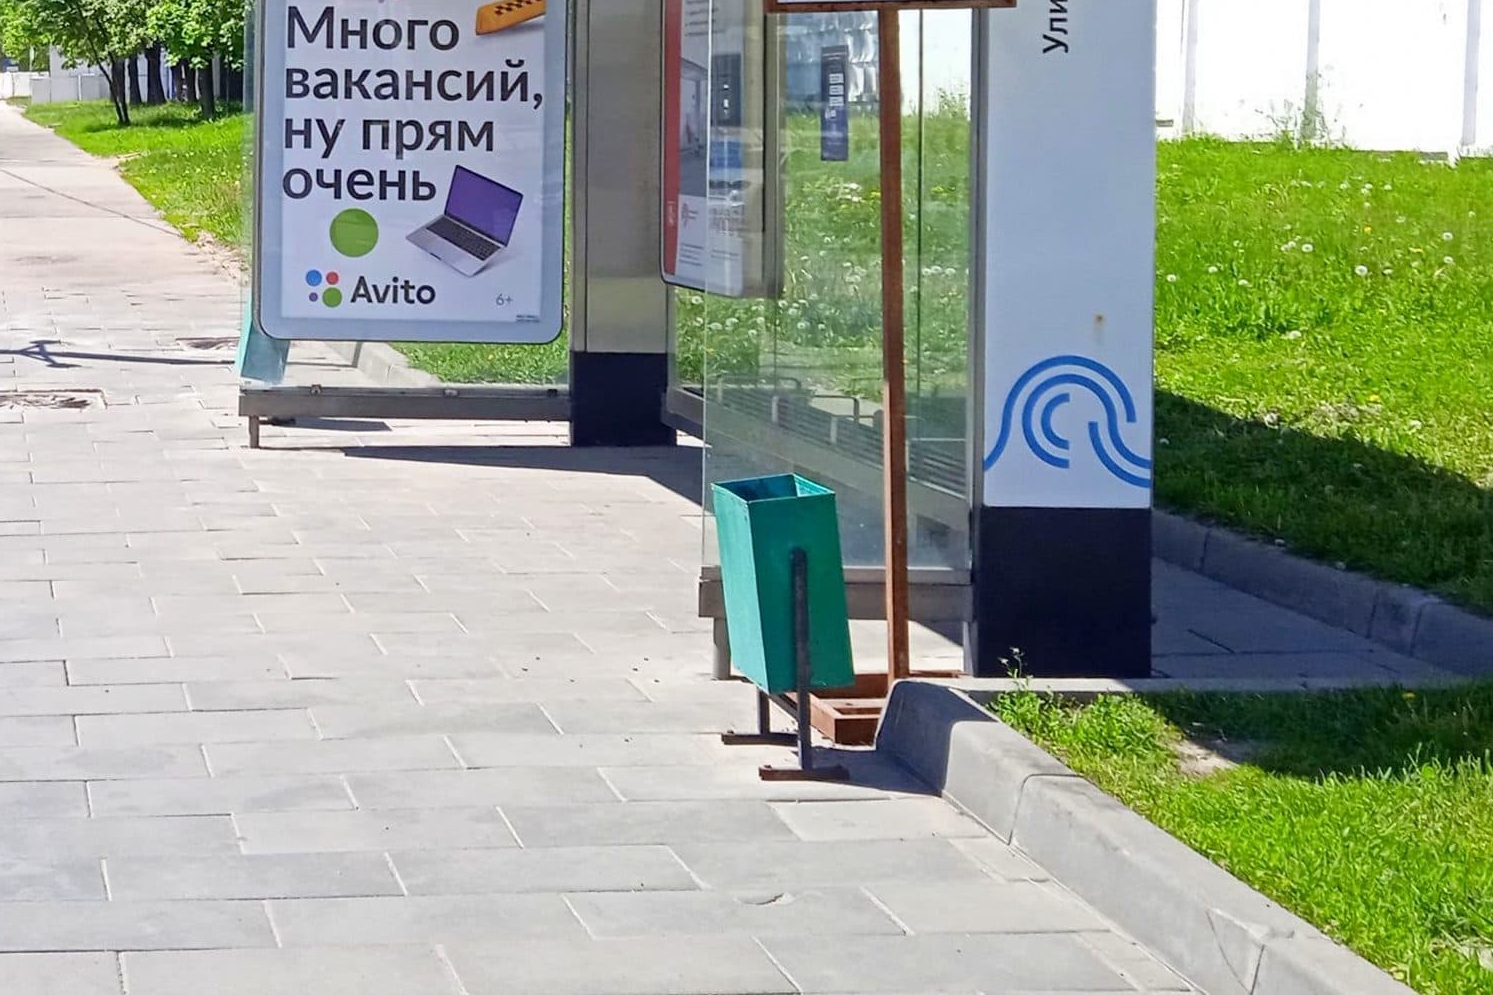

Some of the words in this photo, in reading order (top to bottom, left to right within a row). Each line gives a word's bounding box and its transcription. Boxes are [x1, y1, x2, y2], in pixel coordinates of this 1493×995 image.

[287, 5, 459, 51] Много
[285, 59, 543, 109] вакансий,
[284, 117, 346, 159] ну
[362, 119, 494, 159] прям
[282, 167, 437, 201] очень
[350, 275, 436, 305] Avito
[496, 293, 513, 306] 6+
